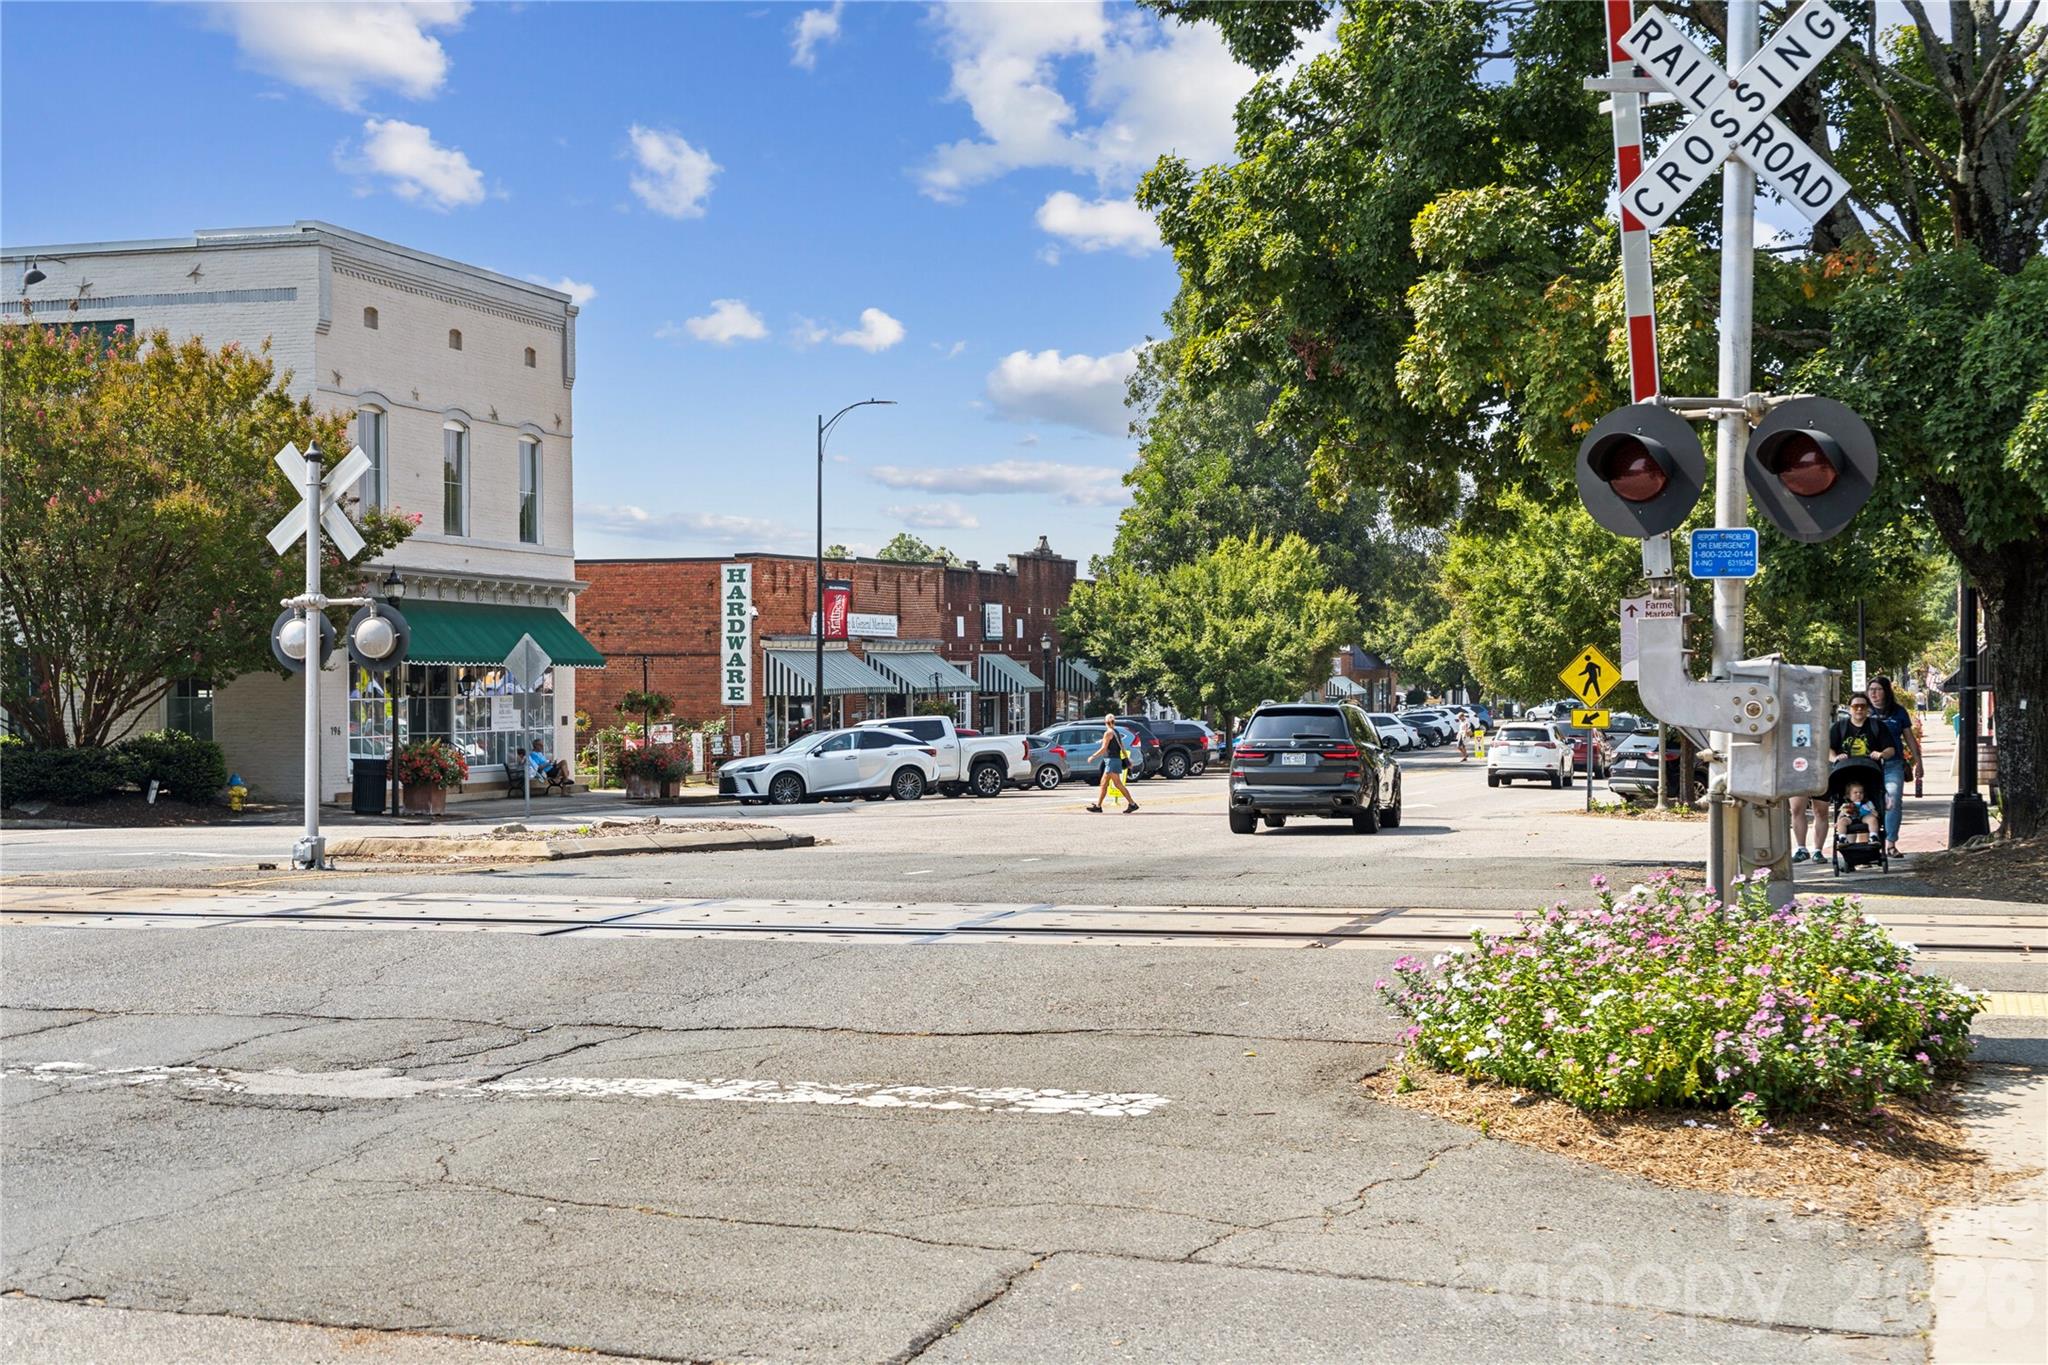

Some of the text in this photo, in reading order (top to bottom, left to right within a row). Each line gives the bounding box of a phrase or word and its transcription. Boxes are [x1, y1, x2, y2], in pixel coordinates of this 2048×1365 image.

[1630, 18, 1833, 208] RAIL ROAD
[1634, 10, 1835, 216] CROSSING
[831, 594, 842, 635] Matthews
[1645, 600, 1673, 609] Farme
[1645, 610, 1674, 618] Market
[726, 568, 746, 700] HARDWARE
[330, 726, 341, 736] 196
